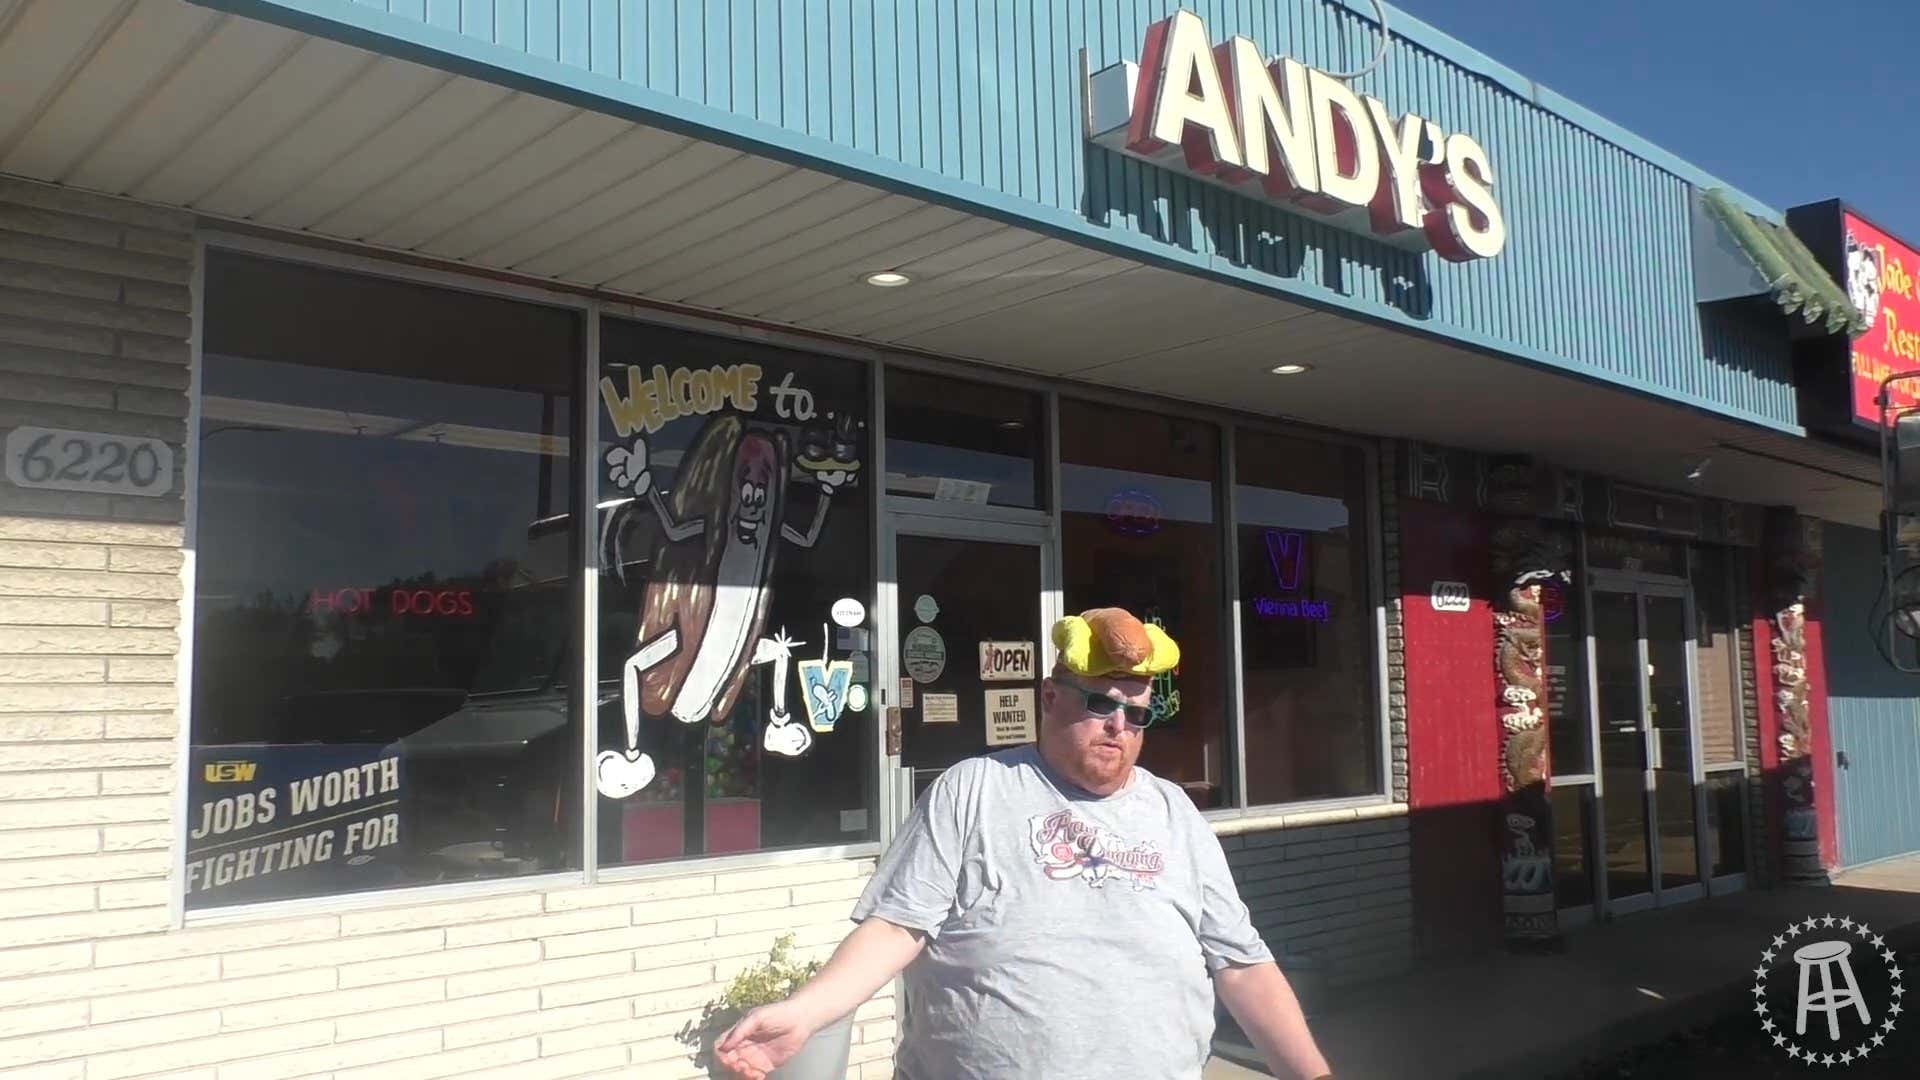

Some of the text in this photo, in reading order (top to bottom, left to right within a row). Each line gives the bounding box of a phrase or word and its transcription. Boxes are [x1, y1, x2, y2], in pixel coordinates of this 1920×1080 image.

[1148, 8, 1506, 260] ANDY'S
[1876, 243, 1913, 300] Jade
[600, 364, 762, 437] WELCOME
[21, 434, 158, 487] 6220
[306, 588, 473, 616] HOT DOGS
[1254, 598, 1328, 621] Vienna Beef
[1436, 585, 1467, 608] 6222
[994, 648, 1030, 672] OPEN
[999, 695, 1019, 708] HELP
[992, 710, 1027, 724] WANTED
[205, 762, 257, 782] USW
[191, 756, 399, 840] JOBS WORTH
[184, 813, 399, 895] FIGHTING FOR
